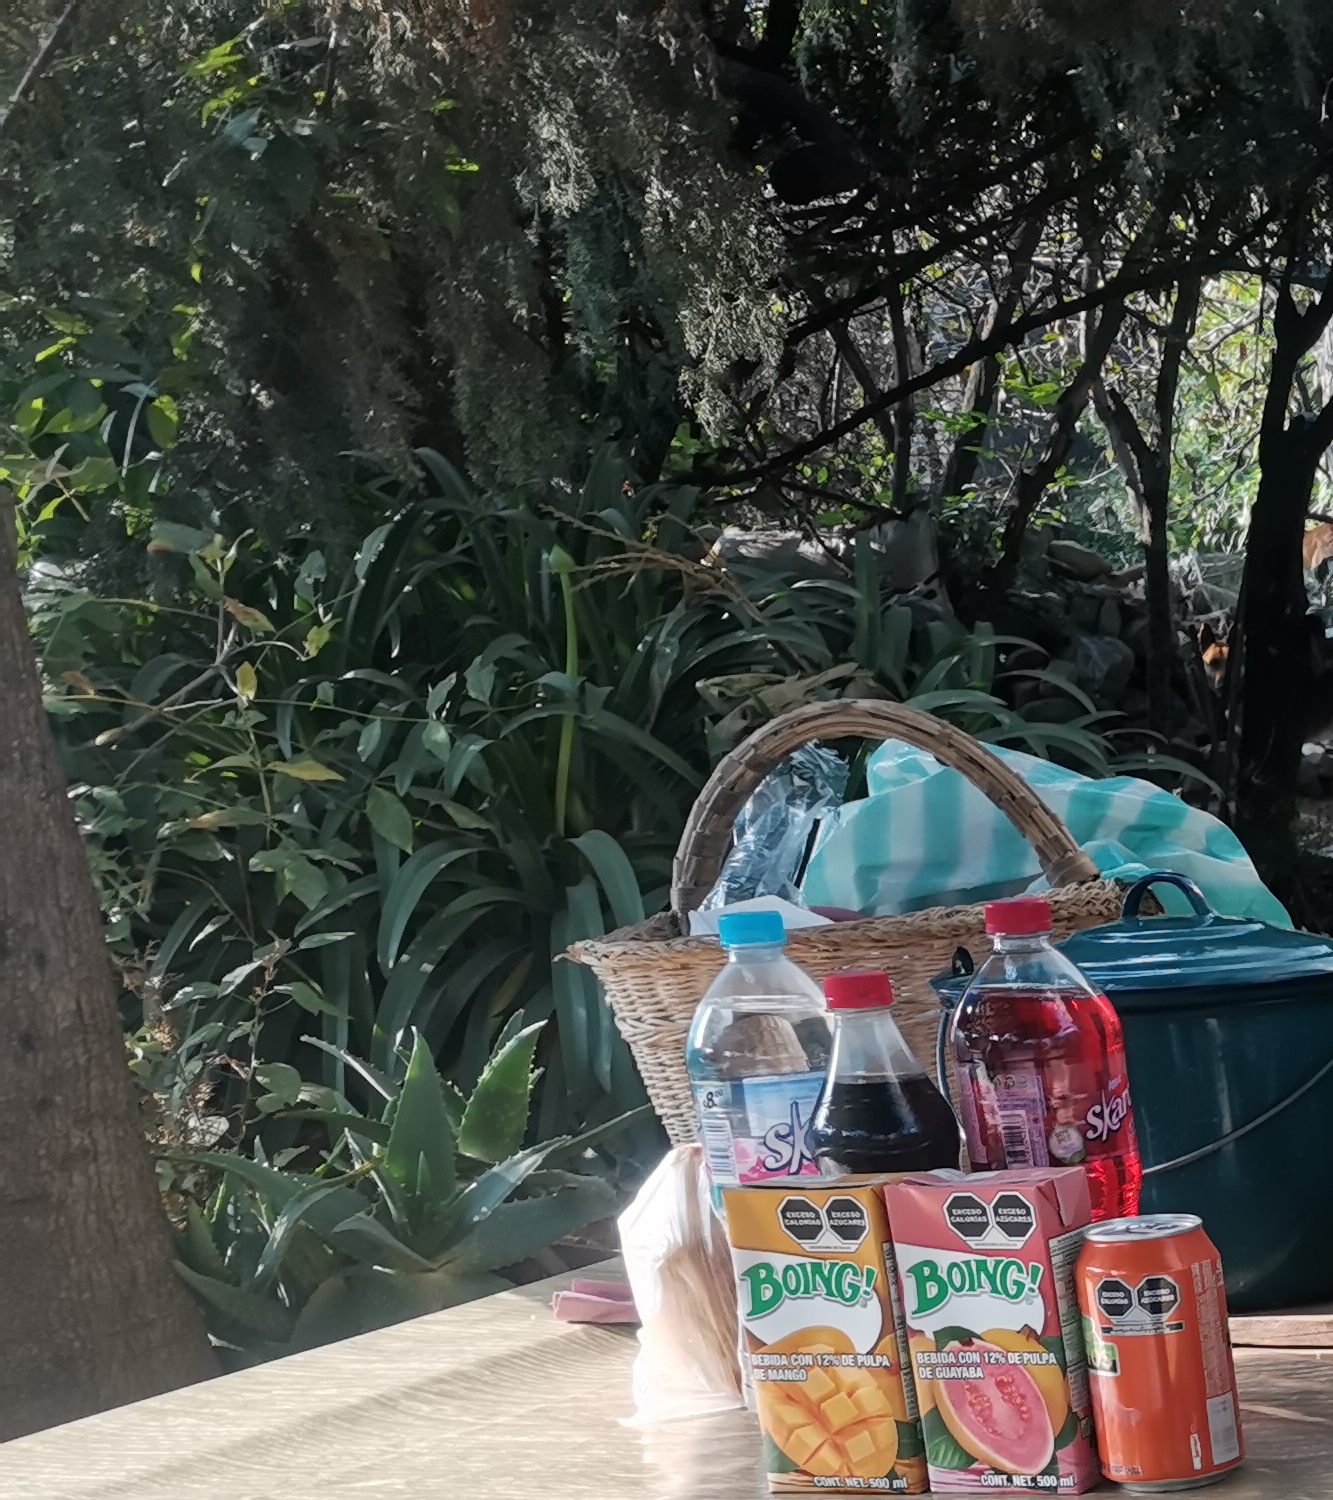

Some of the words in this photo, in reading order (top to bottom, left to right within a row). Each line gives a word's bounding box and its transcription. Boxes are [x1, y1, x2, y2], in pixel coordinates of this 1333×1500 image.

[740, 1261, 878, 1318] BOING!
[906, 1258, 1043, 1316] BOING!
[751, 1353, 789, 1366] BEBIDA
[790, 1354, 813, 1367] CON
[816, 1354, 839, 1367] 12%
[841, 1355, 856, 1366] DE
[857, 1355, 891, 1368] PULPA
[916, 1352, 957, 1365] BEBIDA
[958, 1352, 980, 1365] CON
[984, 1352, 1005, 1365] 12%
[1008, 1353, 1022, 1365] DE
[1023, 1353, 1058, 1366] PULPA
[753, 1368, 767, 1381] DE
[768, 1369, 807, 1382] MANGO
[918, 1366, 933, 1379] DE
[935, 1366, 984, 1379] GUAYABA
[868, 1477, 890, 1489] 500
[893, 1476, 908, 1490] ml
[980, 1474, 1012, 1487] CONT.
[1036, 1475, 1057, 1487] 500
[1059, 1475, 1075, 1487] ml
